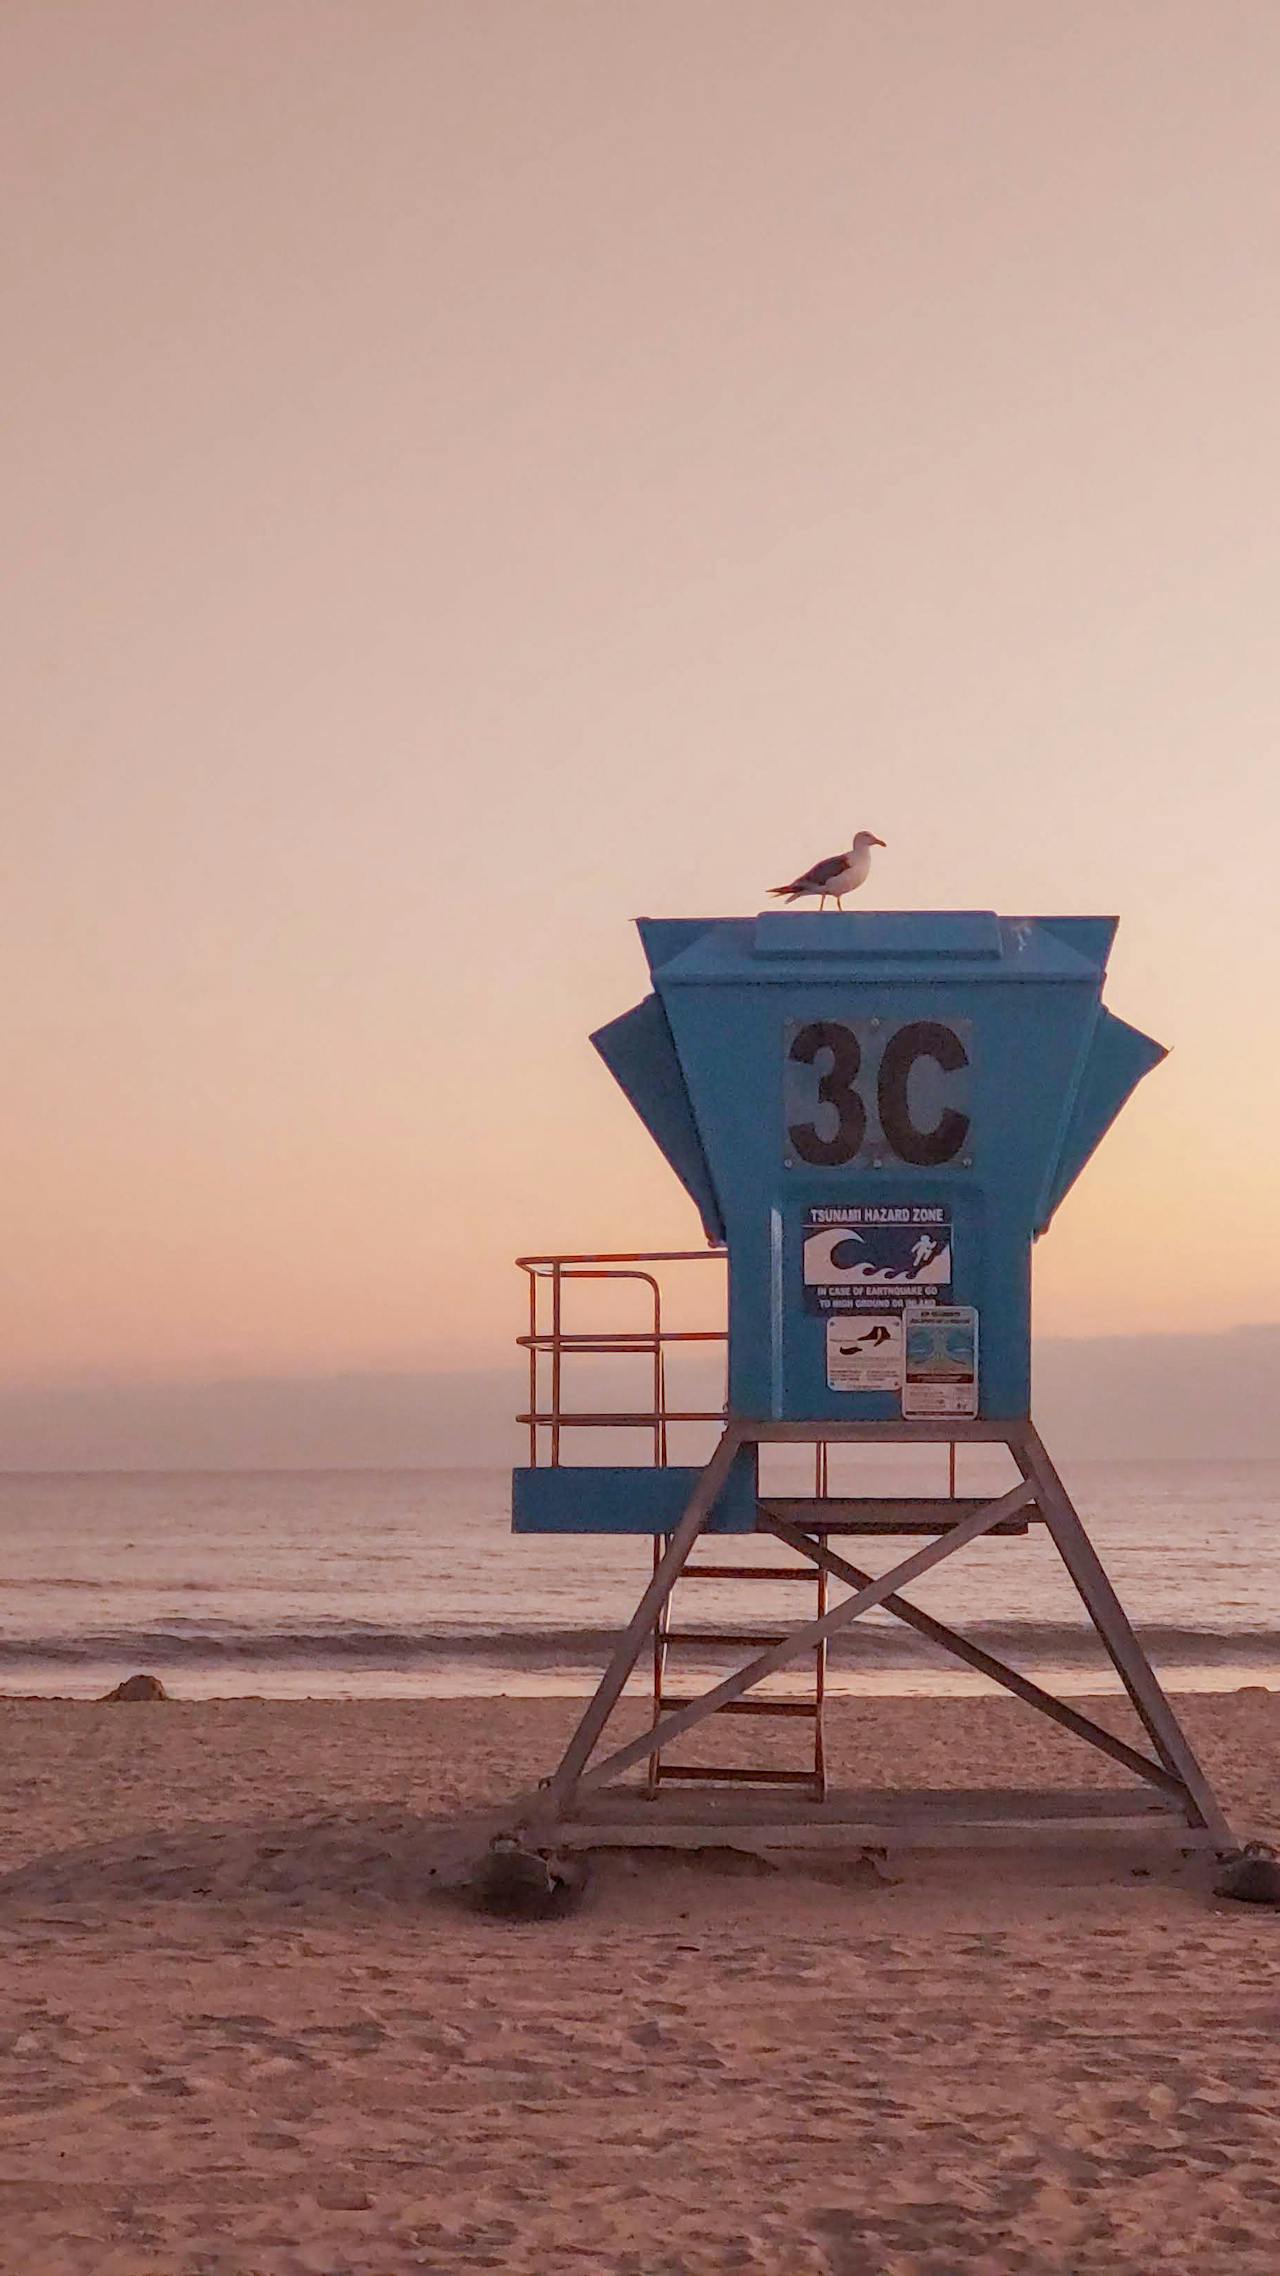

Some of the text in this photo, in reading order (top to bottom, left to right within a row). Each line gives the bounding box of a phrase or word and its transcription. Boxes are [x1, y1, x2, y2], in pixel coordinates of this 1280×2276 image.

[789, 1021, 970, 1166] 3C
[811, 1209, 943, 1221] TSUNAMI HAZARD ZONE
[817, 1286, 938, 1296] IN CASE OF EARTHQUAKE GO
[820, 1300, 831, 1308] TO
